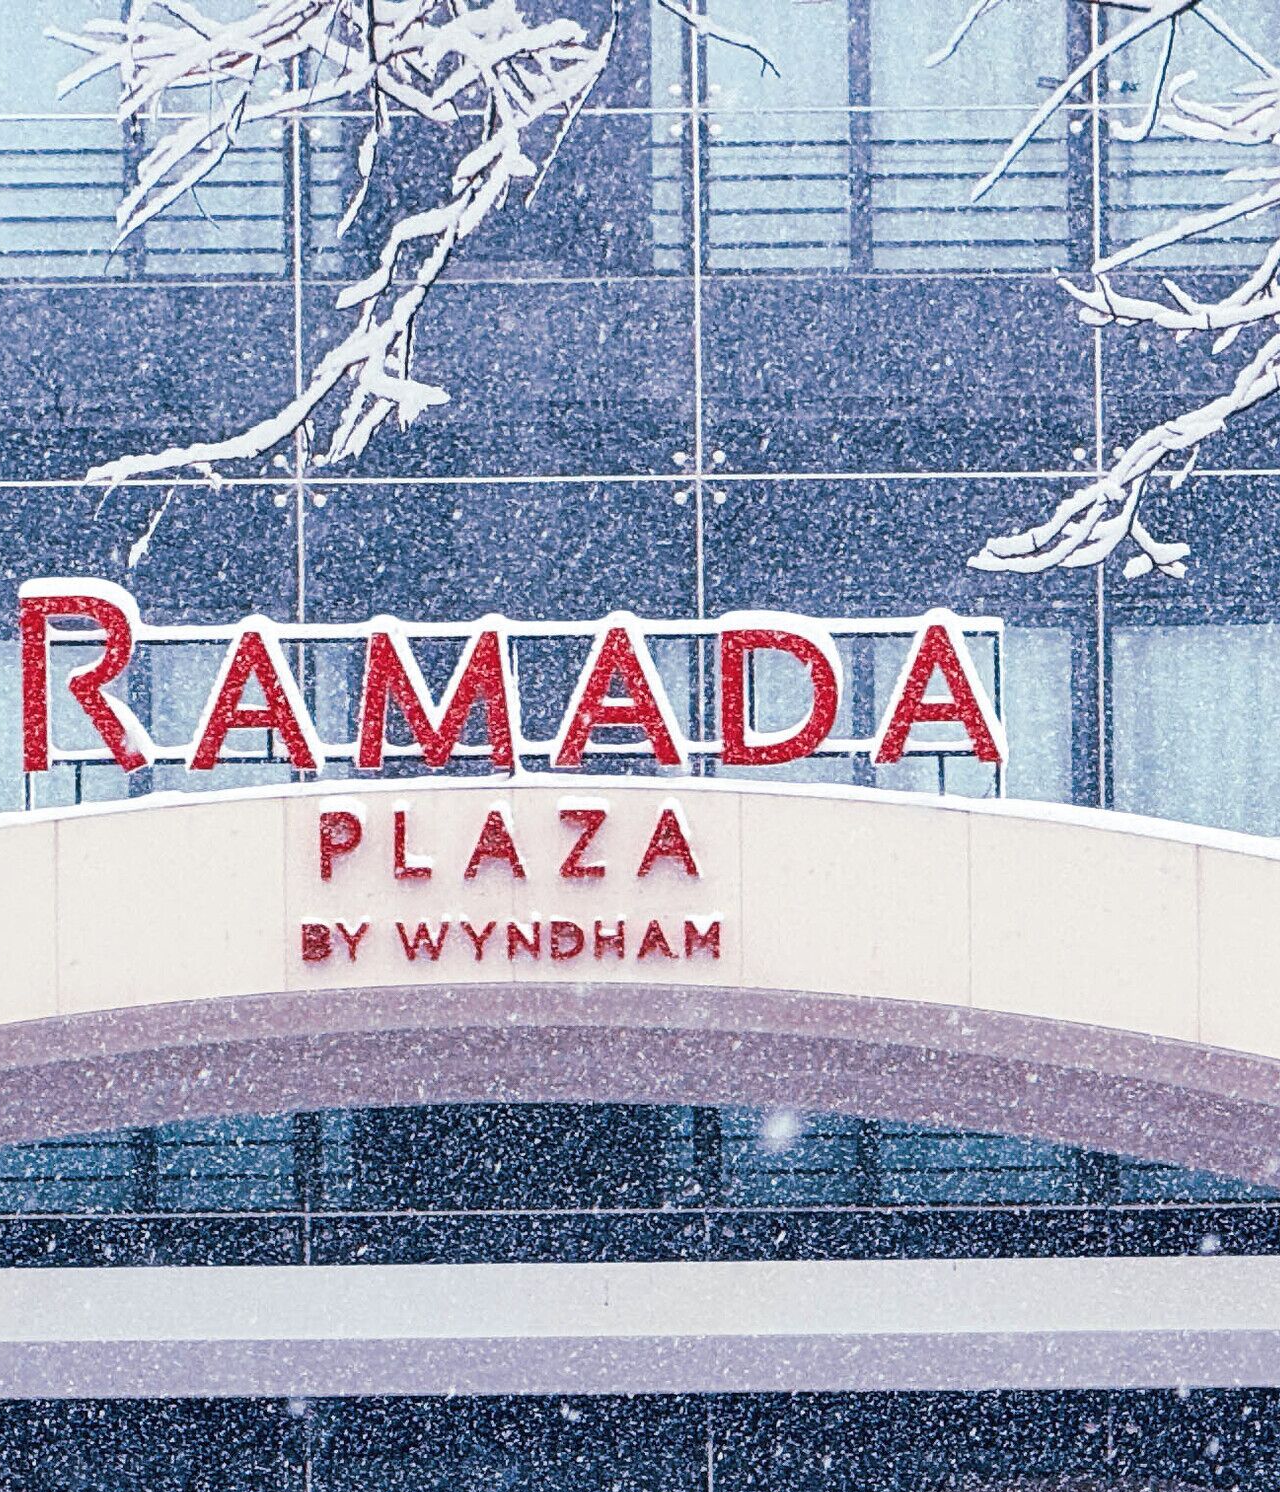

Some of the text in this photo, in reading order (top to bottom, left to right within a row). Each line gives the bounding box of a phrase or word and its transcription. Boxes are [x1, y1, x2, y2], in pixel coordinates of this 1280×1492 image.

[18, 595, 1002, 774] RAMADA
[318, 808, 700, 883] PLAZA
[300, 920, 722, 964] BY WYNDHAM
